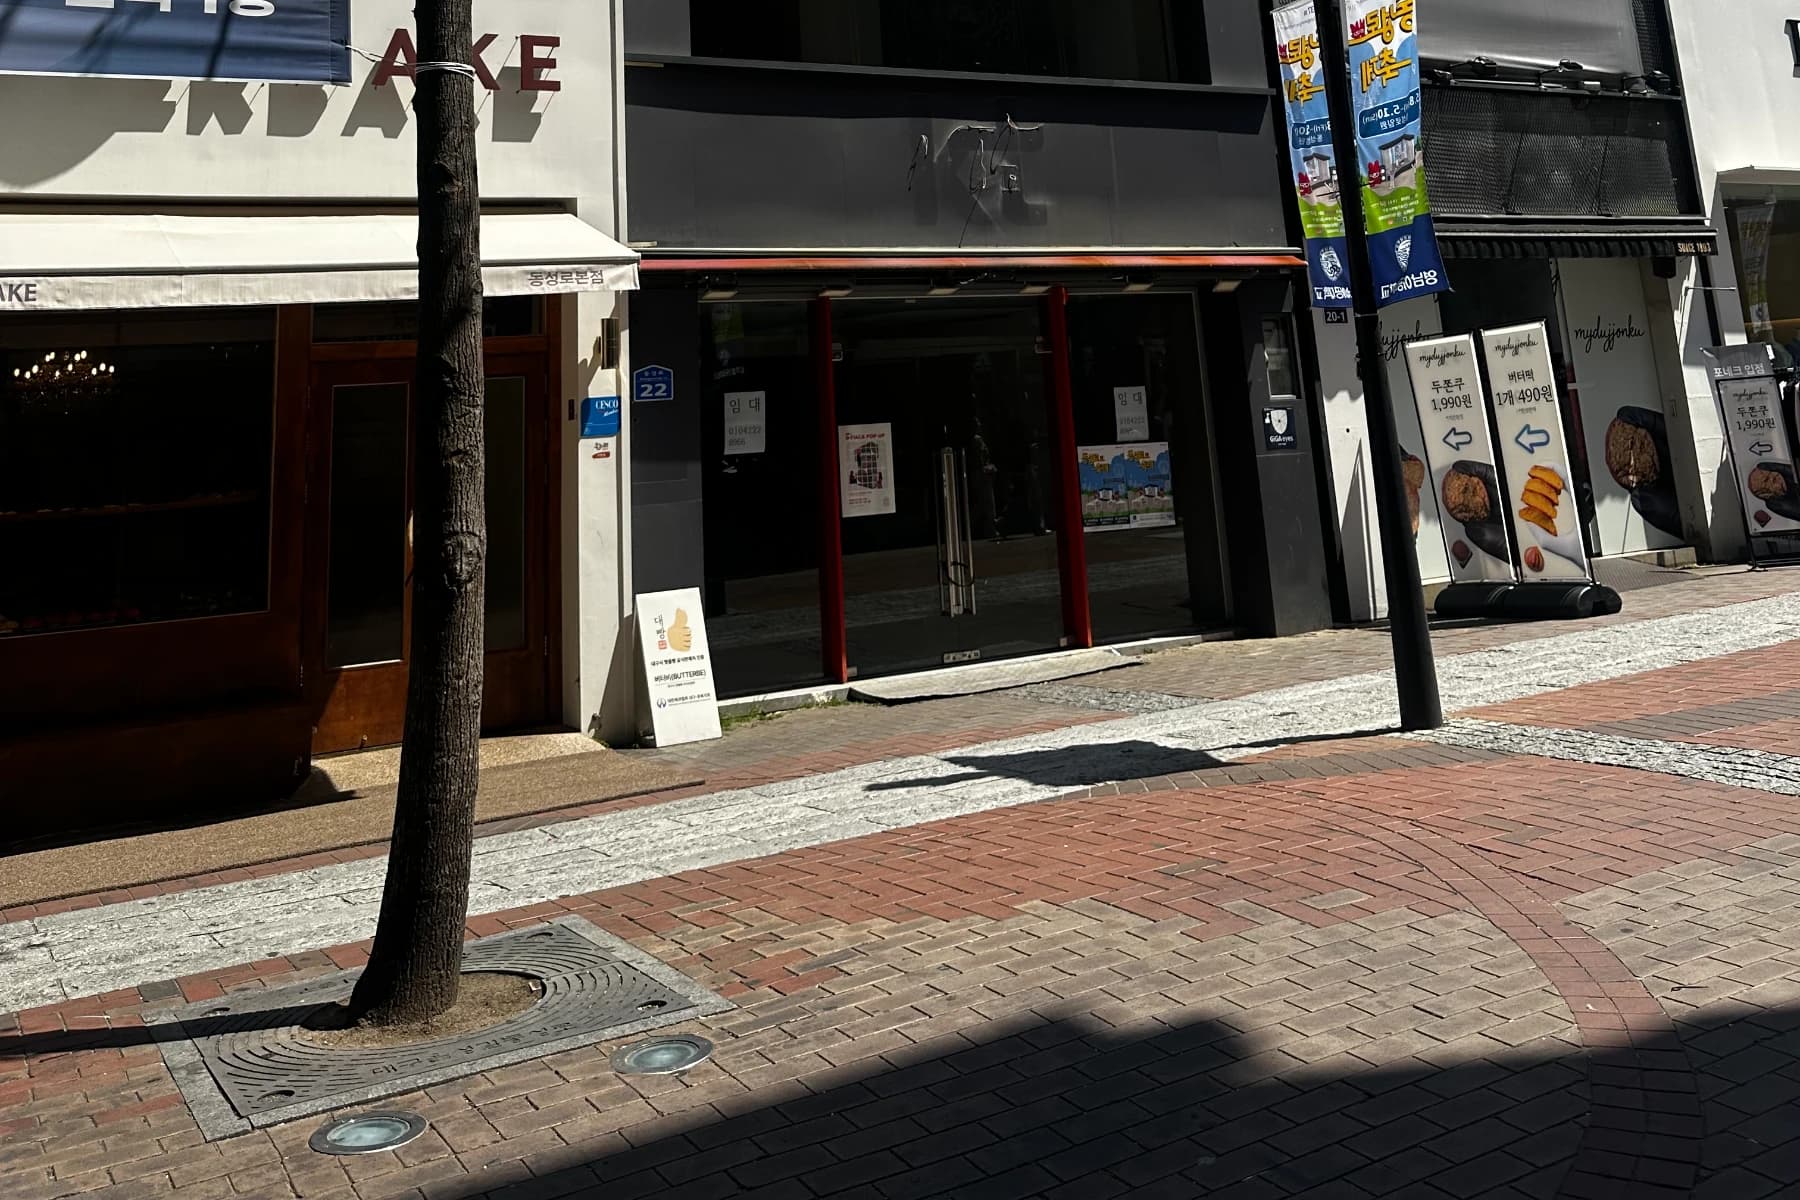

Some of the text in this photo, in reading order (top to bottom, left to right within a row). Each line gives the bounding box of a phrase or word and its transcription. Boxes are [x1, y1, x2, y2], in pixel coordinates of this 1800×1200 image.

[528, 270, 604, 287] 동성로본점
[1326, 311, 1345, 322] 20-1
[1574, 313, 1646, 354] mydujjonku
[640, 383, 668, 398] 22
[1431, 377, 1465, 394] 두쫀쿠
[1431, 393, 1473, 412] 1,990원
[1496, 384, 1554, 406] 1개 490원
[595, 399, 619, 410] CESCO
